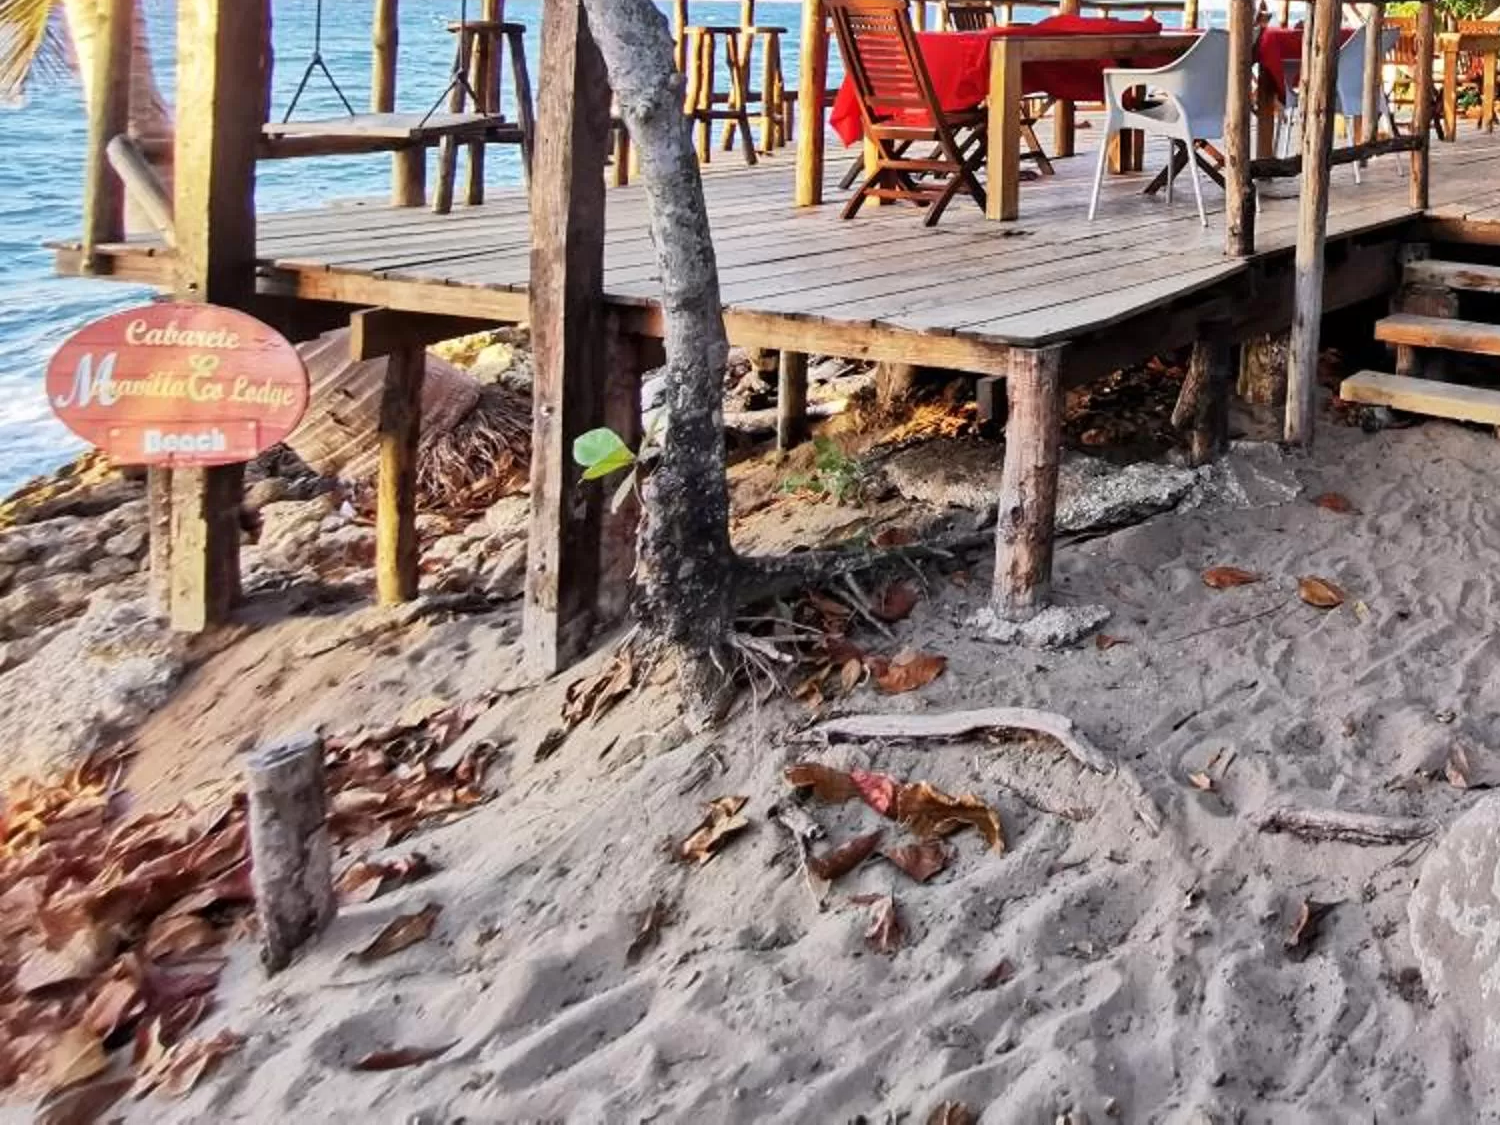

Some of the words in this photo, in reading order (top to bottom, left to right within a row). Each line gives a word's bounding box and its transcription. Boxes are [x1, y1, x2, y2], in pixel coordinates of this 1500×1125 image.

[126, 318, 241, 349] Cabarete
[232, 378, 296, 412] Lodge
[143, 426, 228, 454] Beach
